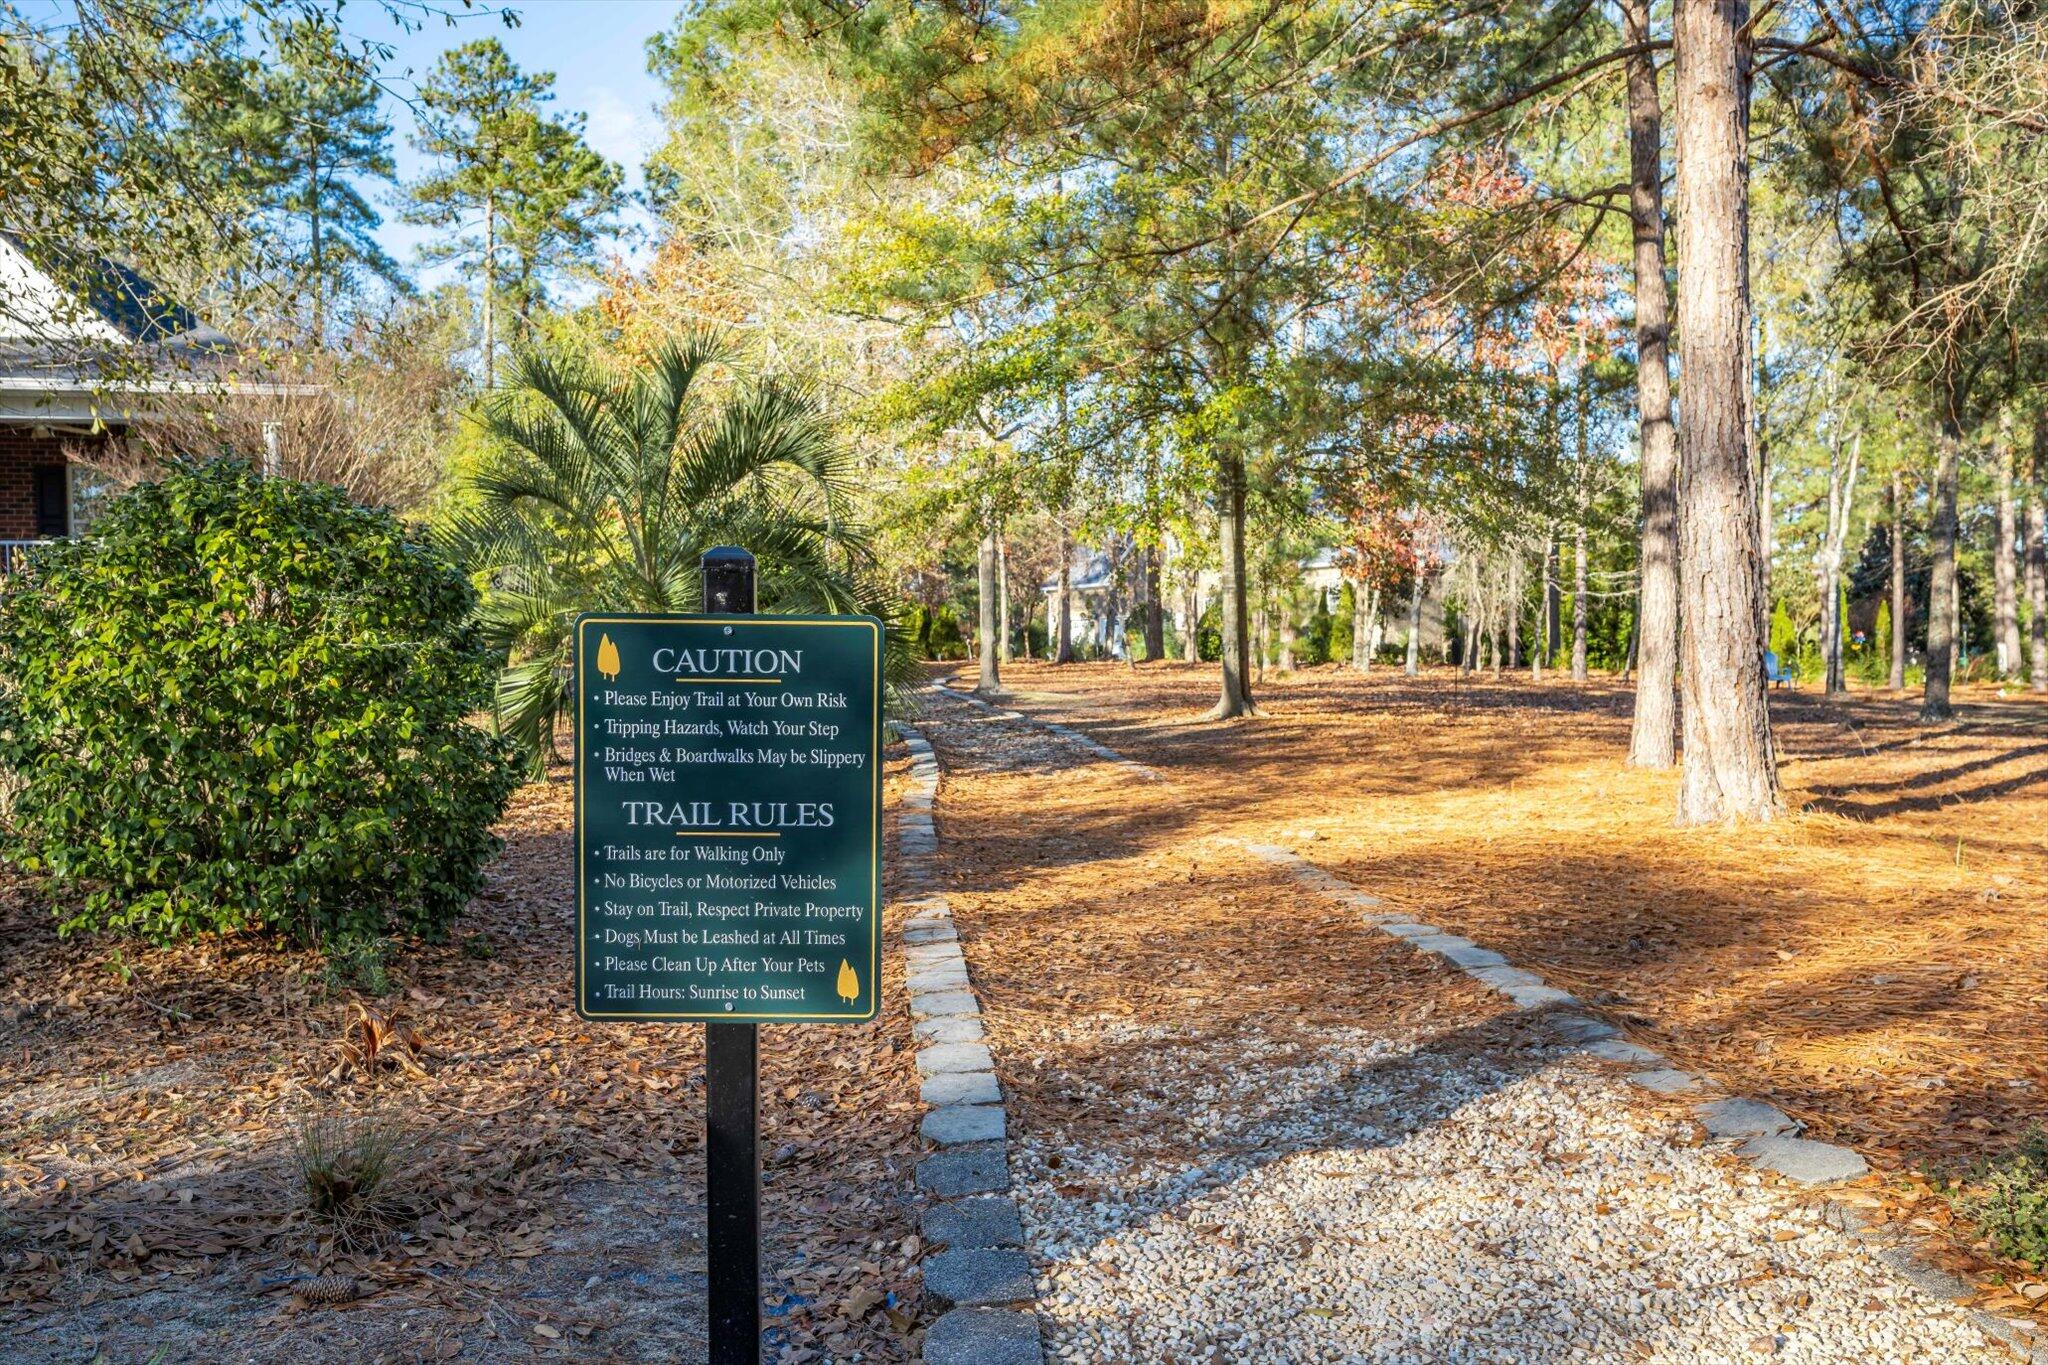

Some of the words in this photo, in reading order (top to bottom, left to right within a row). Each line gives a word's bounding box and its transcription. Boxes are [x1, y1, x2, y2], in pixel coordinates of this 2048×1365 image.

[653, 649, 803, 673] CAUTION
[605, 690, 647, 705] Please
[651, 691, 690, 710] Enjoy
[693, 692, 723, 706] Trail
[728, 694, 740, 706] at
[745, 692, 777, 707] Your
[781, 692, 812, 707] Own
[817, 693, 847, 707] Risk
[605, 719, 660, 738] Tripping
[664, 720, 723, 737] Hazards,
[728, 720, 768, 735] Watch
[773, 721, 805, 735] Your
[809, 721, 839, 740] Step
[605, 747, 656, 766] Bridges
[659, 748, 671, 762] &
[676, 748, 753, 763] Boardwalks
[758, 749, 787, 767] May
[791, 749, 806, 763] be
[811, 749, 865, 768] Slippery
[606, 767, 644, 782] When
[649, 768, 675, 781] Wet
[623, 802, 721, 825] TRAIL
[729, 802, 834, 827] RULES
[604, 845, 640, 860] Trails
[645, 848, 667, 860] are
[670, 846, 690, 860] for
[694, 846, 748, 865] Walking
[753, 846, 785, 865] Only
[605, 873, 625, 888] No
[630, 873, 684, 891] Bicycles
[687, 876, 701, 889] or
[706, 874, 776, 889] Motorized
[781, 875, 836, 890] Vehicles
[604, 901, 633, 919] Stay
[637, 905, 654, 916] on
[658, 901, 692, 919] Trail,
[696, 901, 750, 920] Respect
[754, 902, 801, 917] Private
[805, 902, 863, 921] Property
[605, 929, 640, 947] Dogs
[644, 929, 678, 944] Must
[682, 929, 698, 944] be
[701, 929, 759, 944] Leashed
[763, 932, 775, 944] at
[780, 930, 800, 944] All
[804, 930, 845, 945] Times
[605, 956, 647, 971] Please
[652, 956, 691, 972] Clean
[696, 957, 717, 975] Up
[720, 958, 757, 972] After
[761, 957, 793, 973] Your
[798, 958, 825, 972] Pets
[605, 984, 634, 998] Trail
[639, 984, 684, 999] Hours:
[690, 985, 739, 1000] Sunrise
[743, 987, 757, 1000] to
[760, 985, 805, 1000] Sunset
